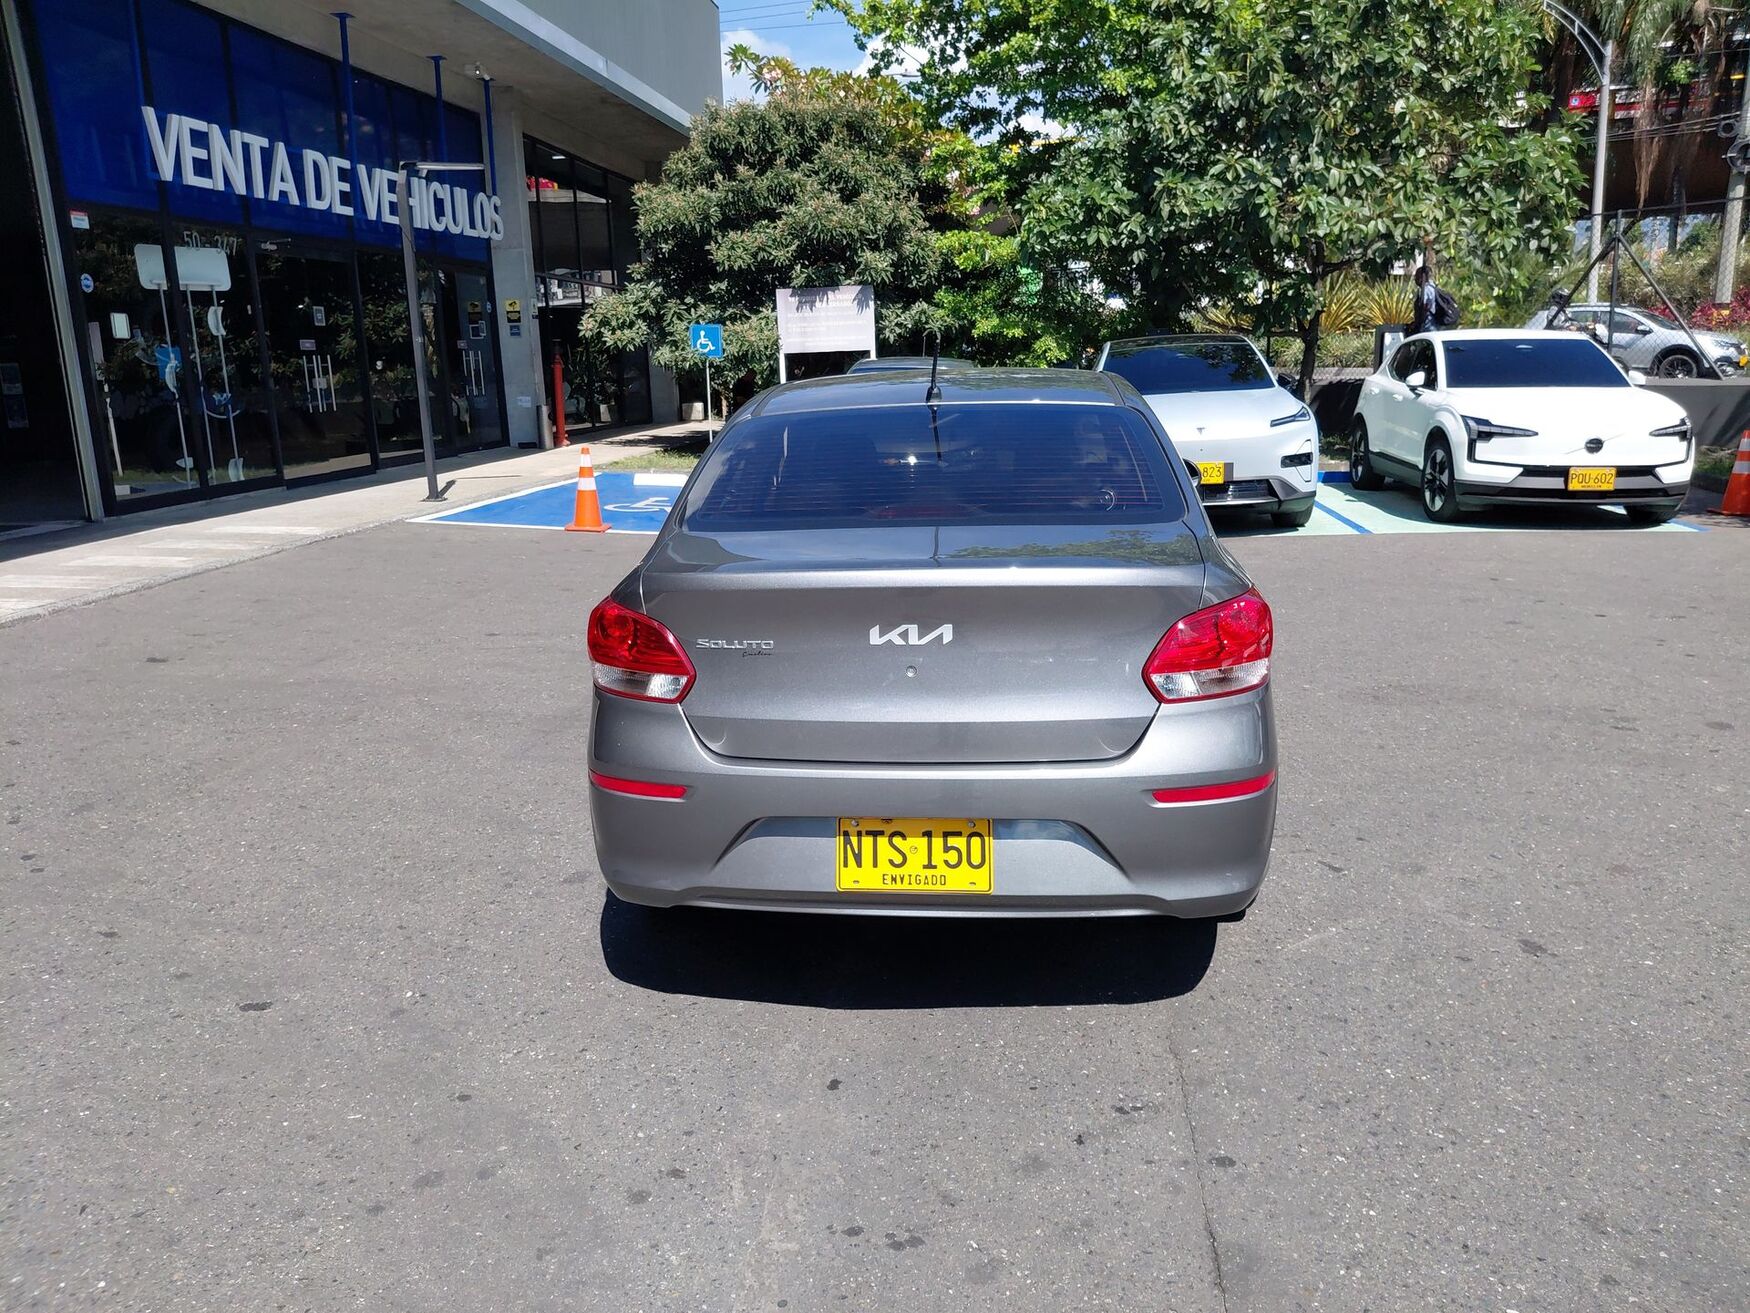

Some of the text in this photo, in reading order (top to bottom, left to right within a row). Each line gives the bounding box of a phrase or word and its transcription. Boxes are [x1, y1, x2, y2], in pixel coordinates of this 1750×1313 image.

[141, 105, 300, 206] VENTA
[303, 148, 354, 216] DE
[1202, 466, 1222, 478] 823
[1593, 472, 1614, 485] 602
[869, 623, 953, 645] KIA
[696, 638, 774, 649] SOLUTO
[842, 830, 986, 869] NTS 150
[882, 873, 947, 886] ENVIGADO
